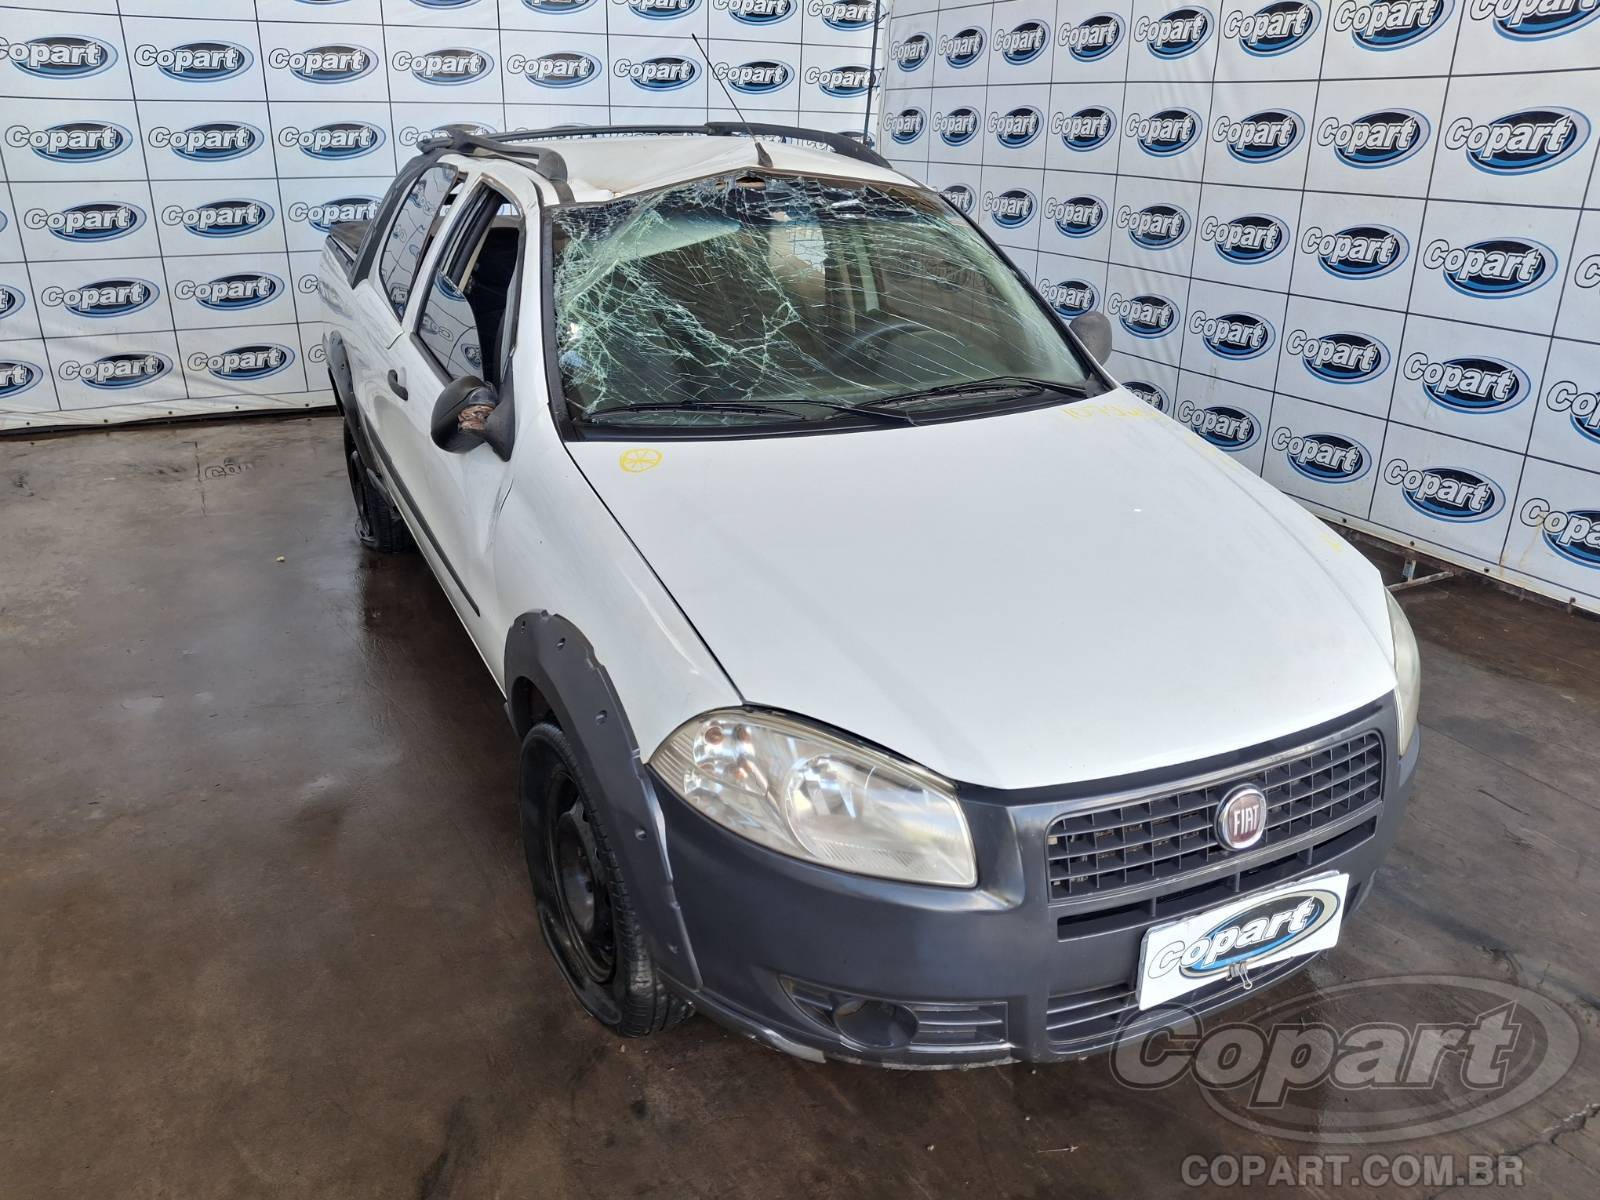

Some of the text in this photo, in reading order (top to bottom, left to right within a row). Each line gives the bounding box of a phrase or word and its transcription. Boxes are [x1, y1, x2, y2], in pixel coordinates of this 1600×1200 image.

[1134, 11, 1204, 49] Copart
[1224, 4, 1309, 45] Copart
[1333, 0, 1437, 37] Copart
[938, 31, 983, 58] Copart
[993, 23, 1045, 55] Copart
[1058, 18, 1117, 51] Copart
[134, 45, 239, 73] Copart
[269, 48, 365, 75] Copart
[392, 51, 481, 77] Copart
[507, 54, 590, 79] Copart
[891, 39, 930, 64] Copart
[615, 58, 692, 82] Copart
[714, 61, 786, 84] Copart
[805, 65, 870, 88] Copart
[884, 111, 922, 134] Copart
[933, 111, 976, 138] Copart
[987, 111, 1038, 141] Copart
[1051, 111, 1110, 141] Copart
[1126, 113, 1193, 145] Copart
[1212, 116, 1294, 148] Copart
[1317, 117, 1416, 155] Copart
[1445, 114, 1577, 160] Copart
[5, 125, 117, 154] Copart
[149, 127, 249, 153] Copart
[279, 127, 373, 152] Copart
[162, 202, 261, 228] Copart
[288, 200, 377, 227] Copart
[983, 191, 1030, 217] Copart
[1045, 197, 1100, 228] Copart
[24, 207, 131, 233] Copart
[1116, 205, 1182, 237] Copart
[1200, 215, 1280, 251] Copart
[1301, 226, 1396, 265] Copart
[1423, 238, 1541, 284] Copart
[41, 284, 145, 311] Copart
[174, 277, 271, 304] Copart
[1039, 279, 1092, 309] Copart
[1108, 293, 1171, 328] Copart
[1189, 310, 1265, 348] Copart
[188, 349, 283, 374] Copart
[1286, 329, 1377, 371] Copart
[59, 356, 159, 384] Copart
[1404, 351, 1515, 401] Copart
[1178, 400, 1250, 441] Copart
[1272, 427, 1358, 473] Copart
[1384, 458, 1489, 512] Copart
[1233, 803, 1260, 835] FIAT
[1147, 896, 1314, 978] Copart
